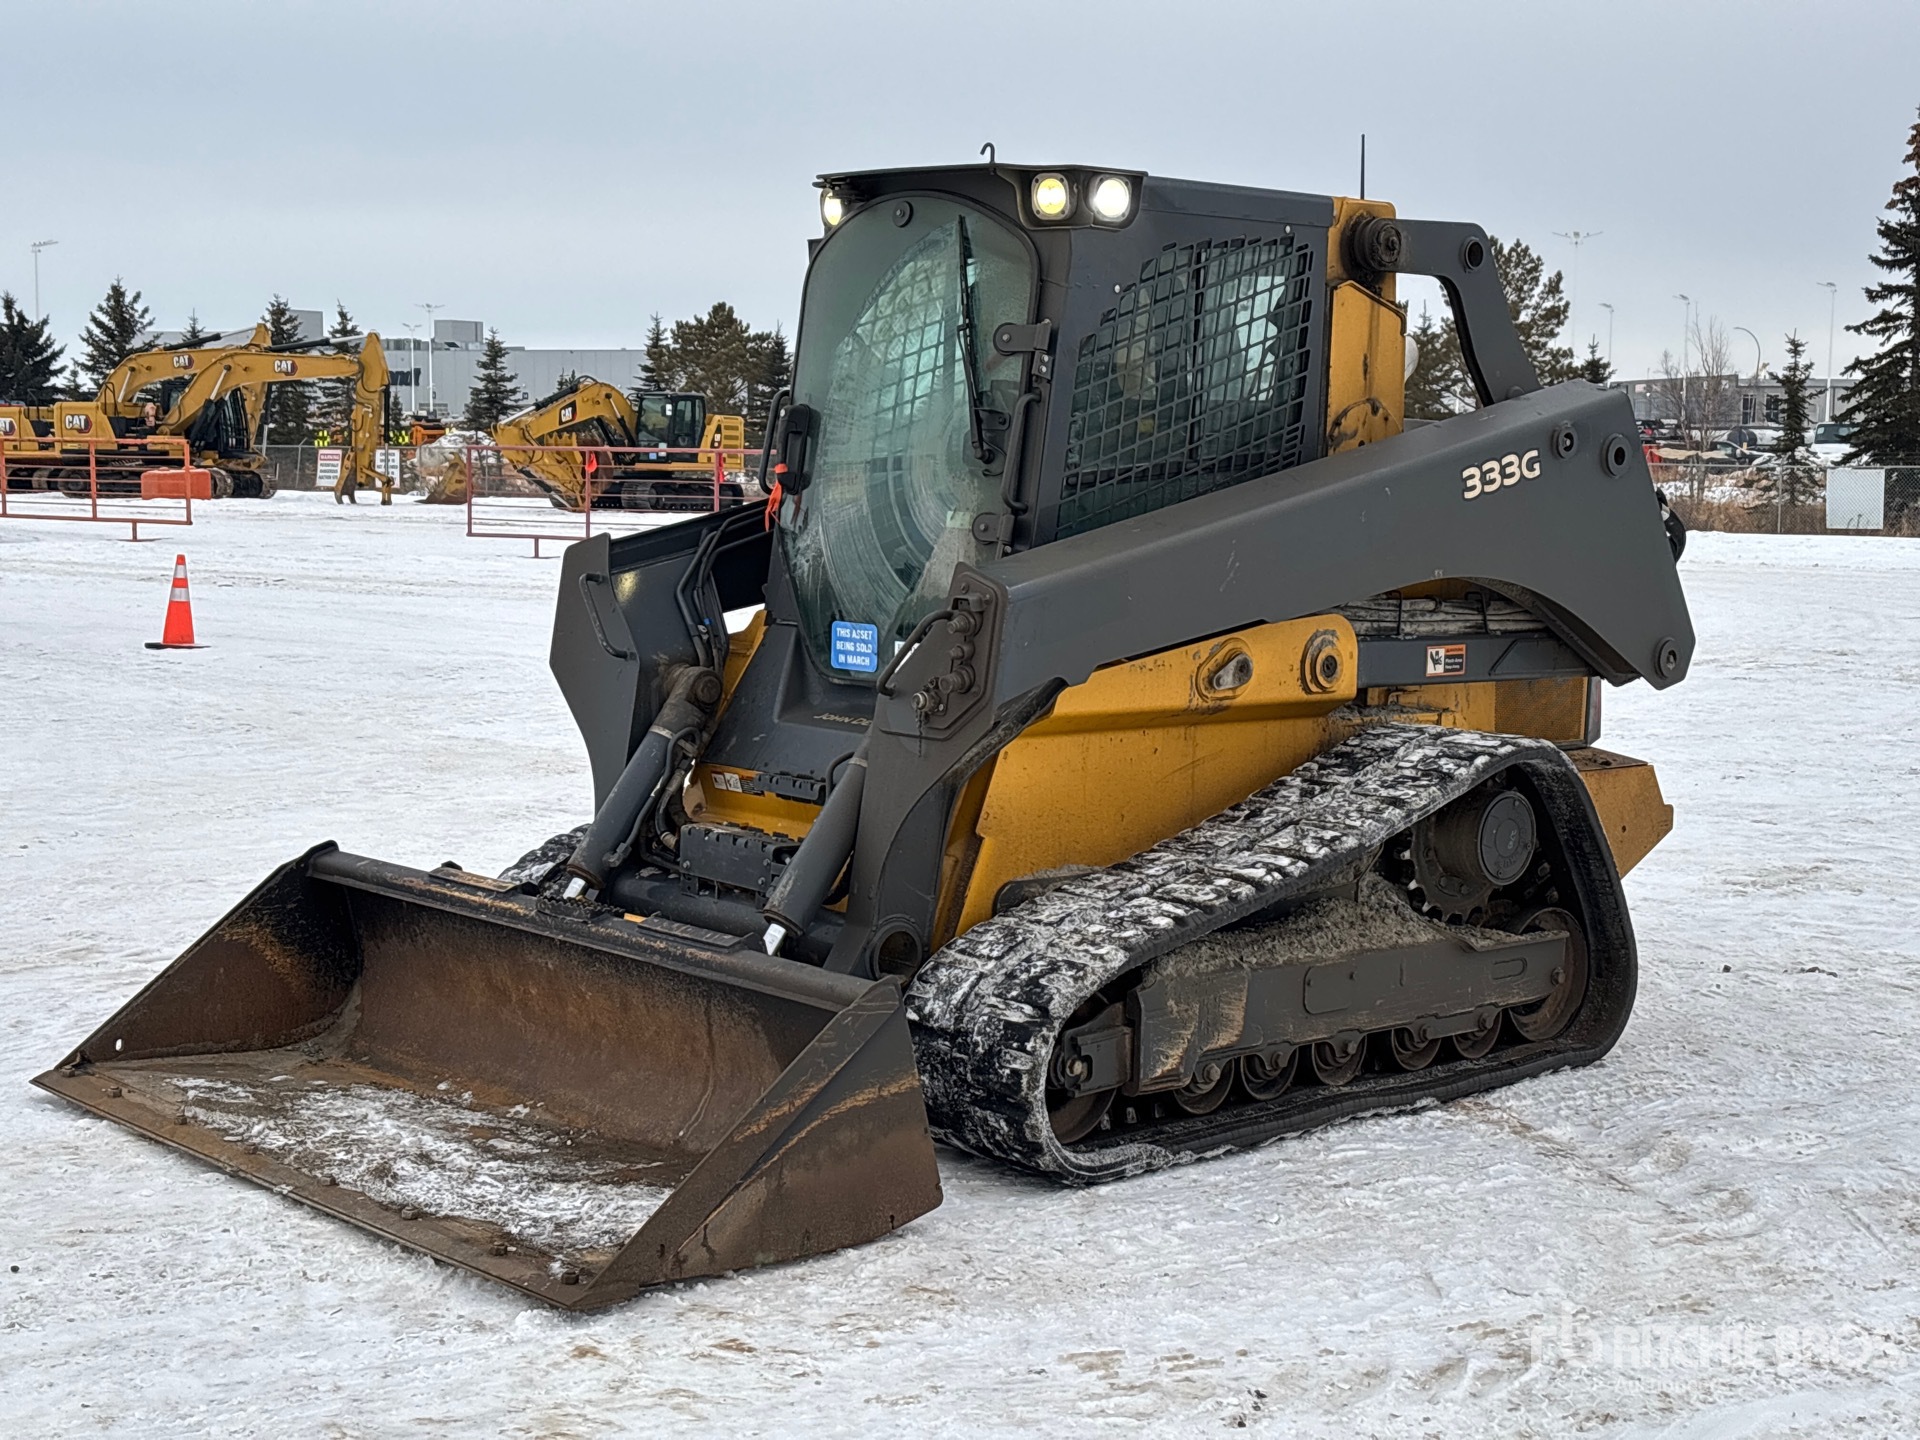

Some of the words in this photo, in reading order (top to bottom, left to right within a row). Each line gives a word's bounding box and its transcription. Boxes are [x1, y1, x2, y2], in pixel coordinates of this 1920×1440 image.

[173, 354, 189, 368] CAT
[274, 359, 293, 373] CAT
[561, 406, 573, 422] CAT
[65, 414, 86, 430] CAT
[1462, 449, 1541, 499] 333G
[836, 627, 851, 638] THIS
[852, 629, 873, 640] ASSET
[836, 640, 855, 652] BEING
[856, 642, 873, 653] SOLD
[838, 653, 846, 664] IN
[847, 654, 870, 666] MARCH
[813, 712, 854, 723] JOHN
